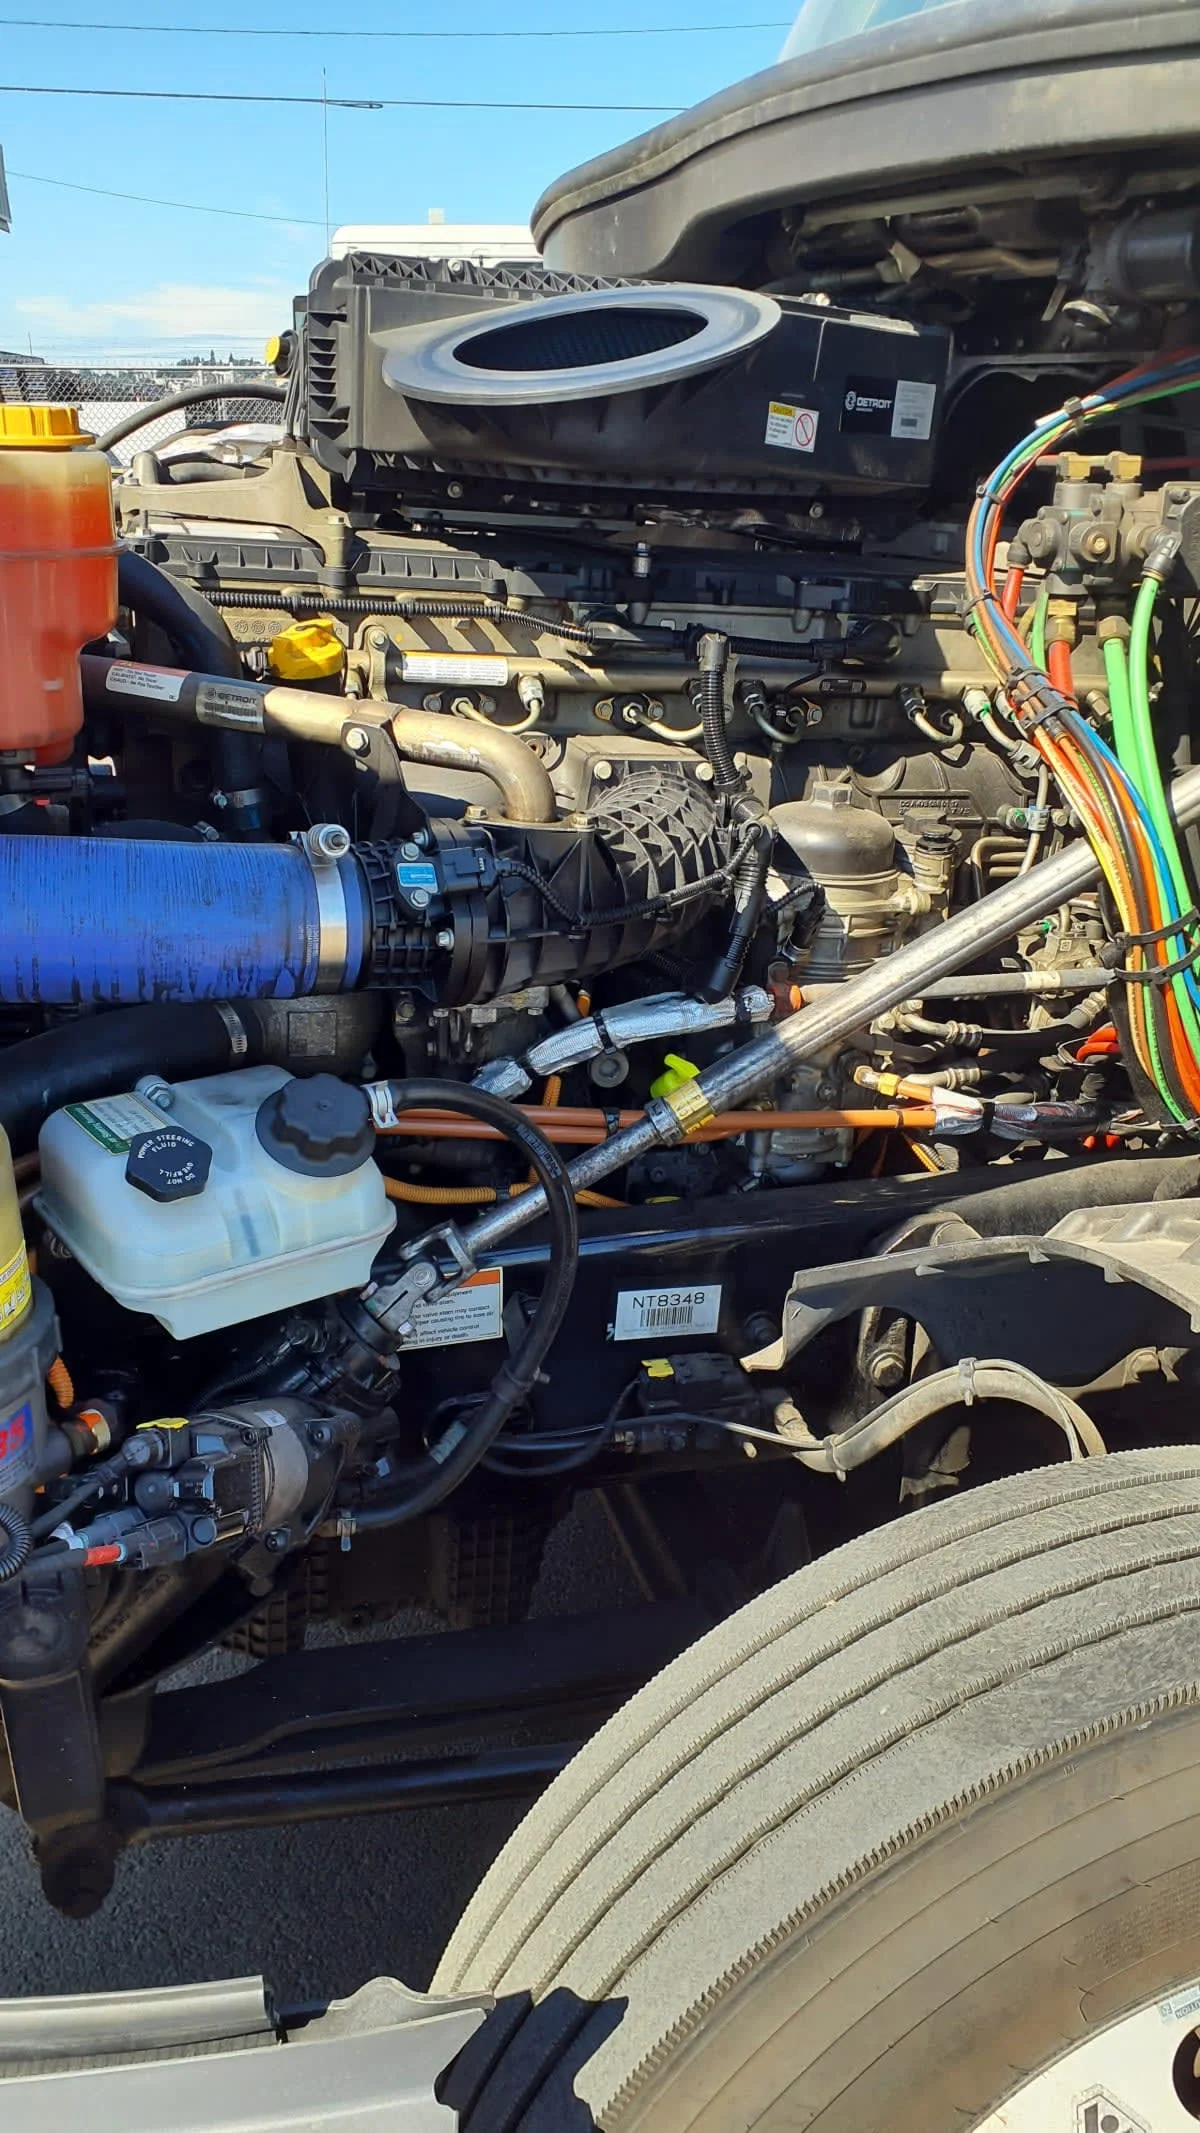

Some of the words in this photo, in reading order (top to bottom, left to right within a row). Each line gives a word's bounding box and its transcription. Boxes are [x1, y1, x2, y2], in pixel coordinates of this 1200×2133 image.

[856, 396, 892, 409] DETROIT
[217, 692, 257, 704] DETROIT
[137, 1139, 154, 1159] POWER
[156, 1134, 194, 1147] STEERING
[152, 1142, 176, 1152] FLUID
[160, 1162, 194, 1177] OVERFILL
[632, 1292, 705, 1309] NT8348
